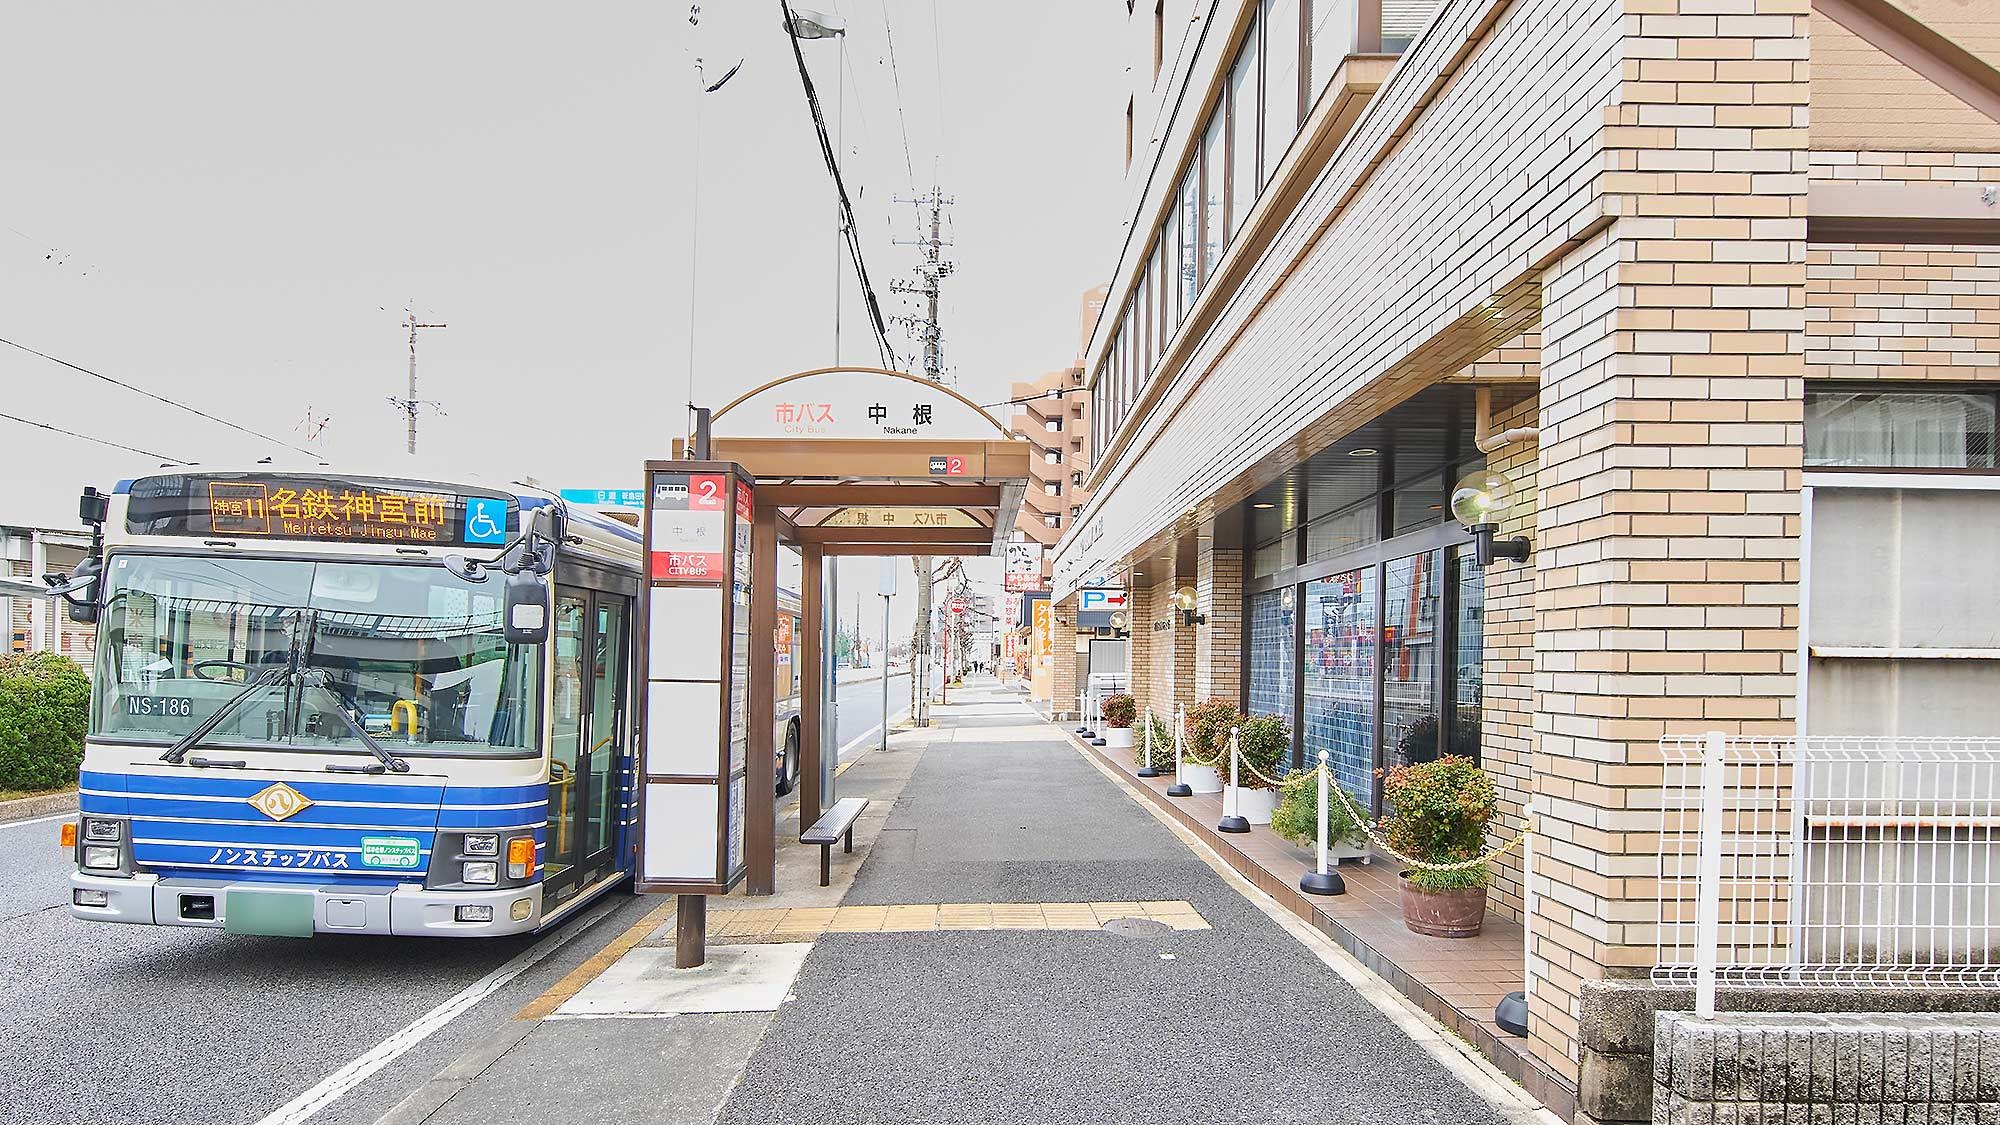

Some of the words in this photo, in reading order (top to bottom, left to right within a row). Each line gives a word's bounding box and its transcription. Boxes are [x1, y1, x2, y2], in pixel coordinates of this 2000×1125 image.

[775, 403, 834, 423] 市バス
[784, 425, 804, 434] City
[807, 425, 825, 433] Bus
[883, 426, 918, 435] Nakane
[950, 458, 962, 473] 2
[698, 480, 718, 506] 2
[269, 488, 447, 525] 名鉄神宮前
[283, 520, 352, 536] Meitetsu
[360, 524, 403, 539] Jingu
[410, 526, 437, 540] Mae
[669, 554, 707, 567] 市バス
[1083, 592, 1106, 608] P
[130, 696, 190, 716] NS-186
[209, 848, 349, 869] ノンステップバス
